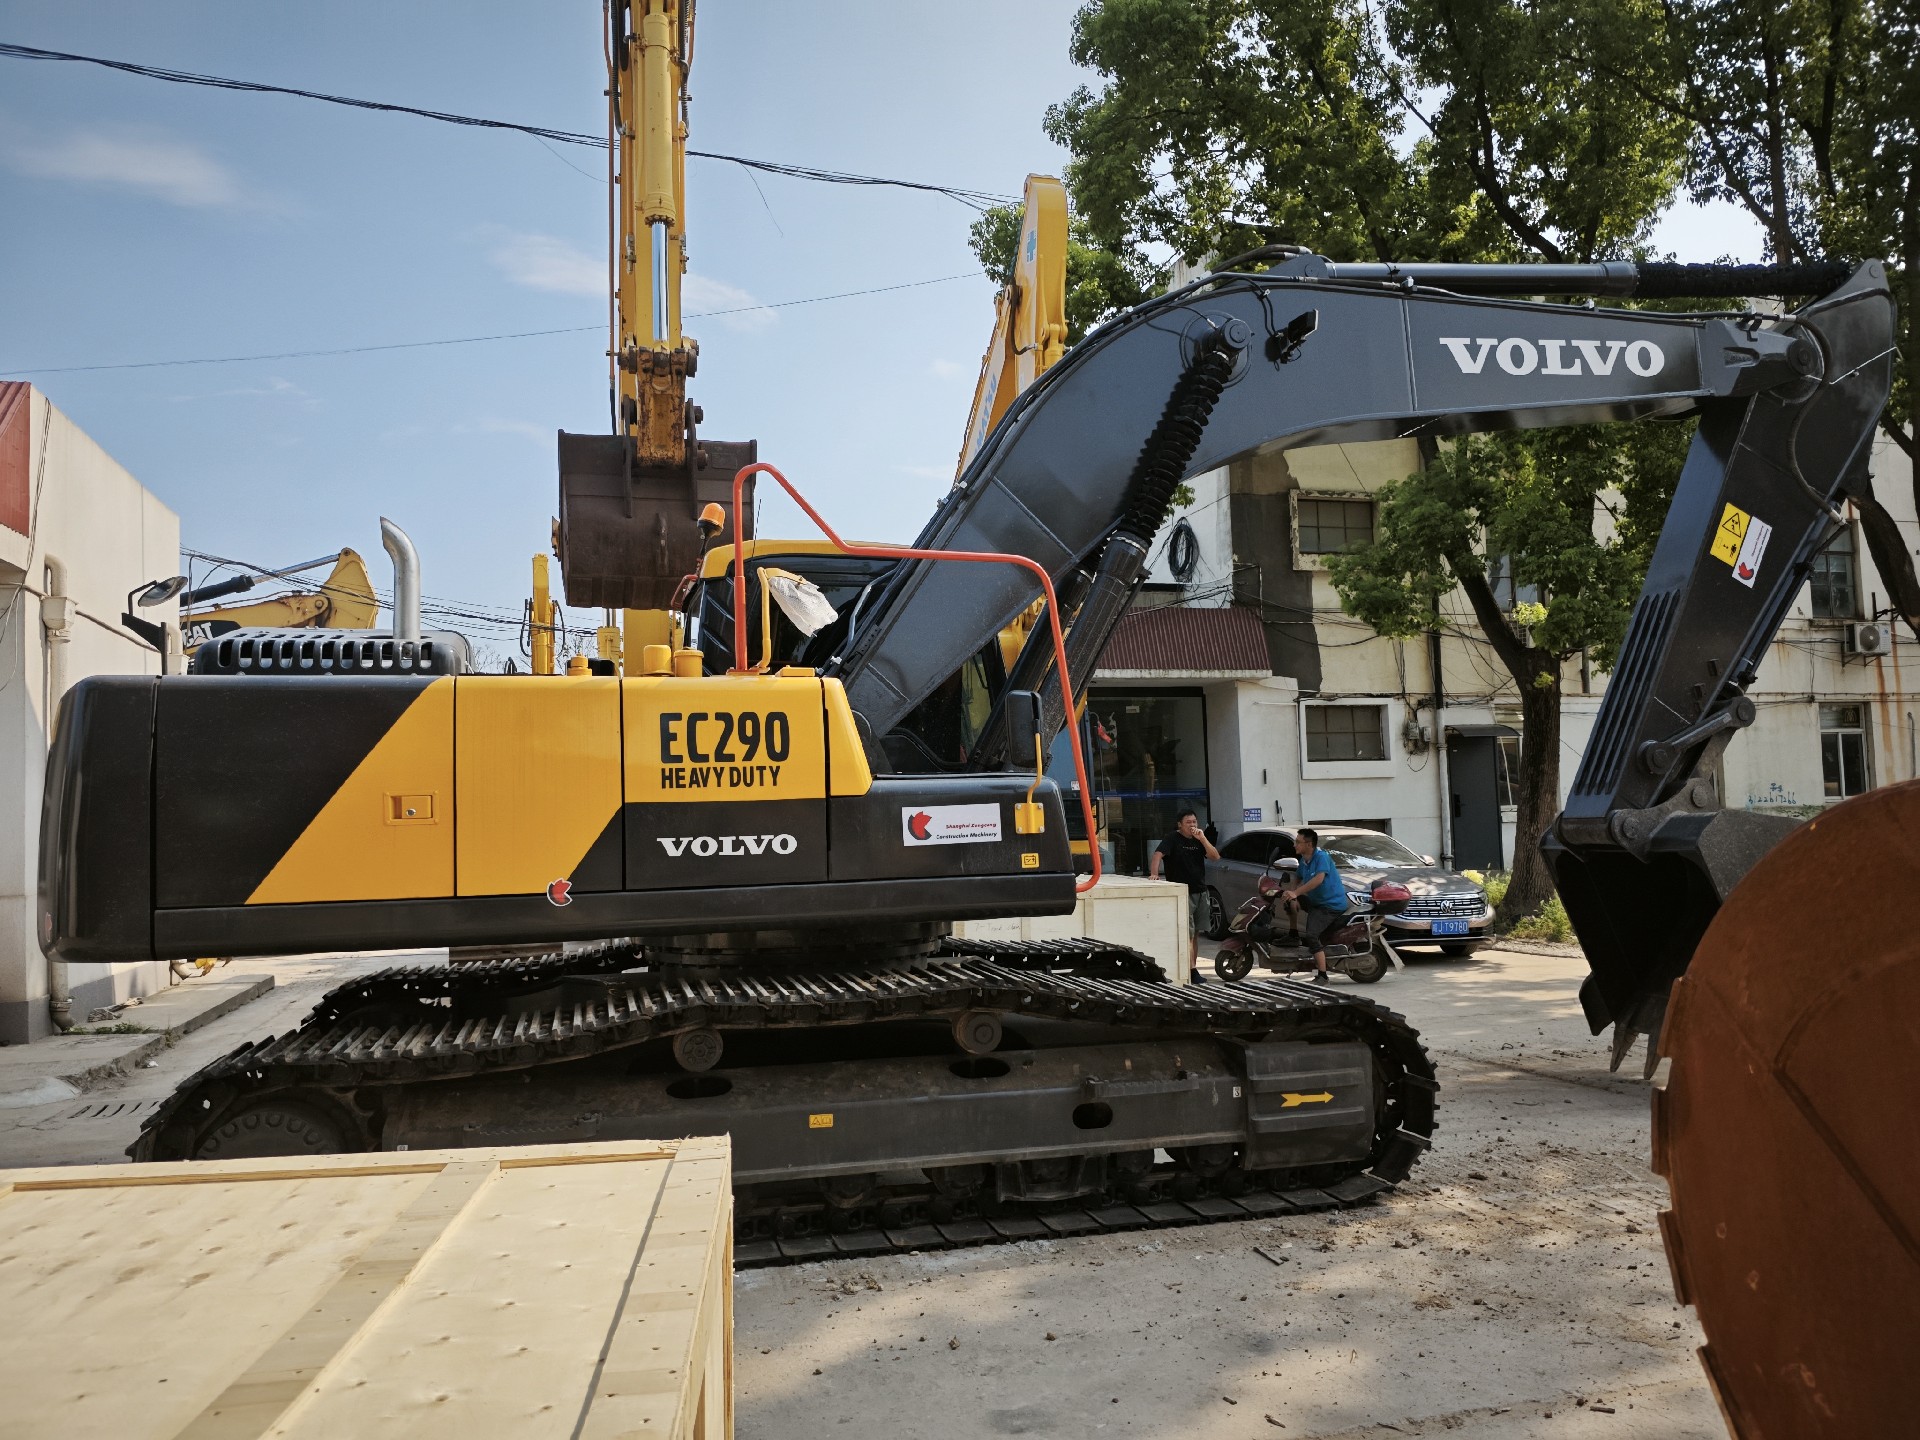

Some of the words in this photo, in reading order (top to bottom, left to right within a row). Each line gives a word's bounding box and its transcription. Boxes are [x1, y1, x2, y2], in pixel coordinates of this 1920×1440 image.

[1439, 337, 1665, 377] VOLVO
[660, 712, 790, 763] EC290
[661, 767, 725, 789] HEAVY
[729, 766, 781, 787] DUTY
[657, 834, 798, 857] VOLVO
